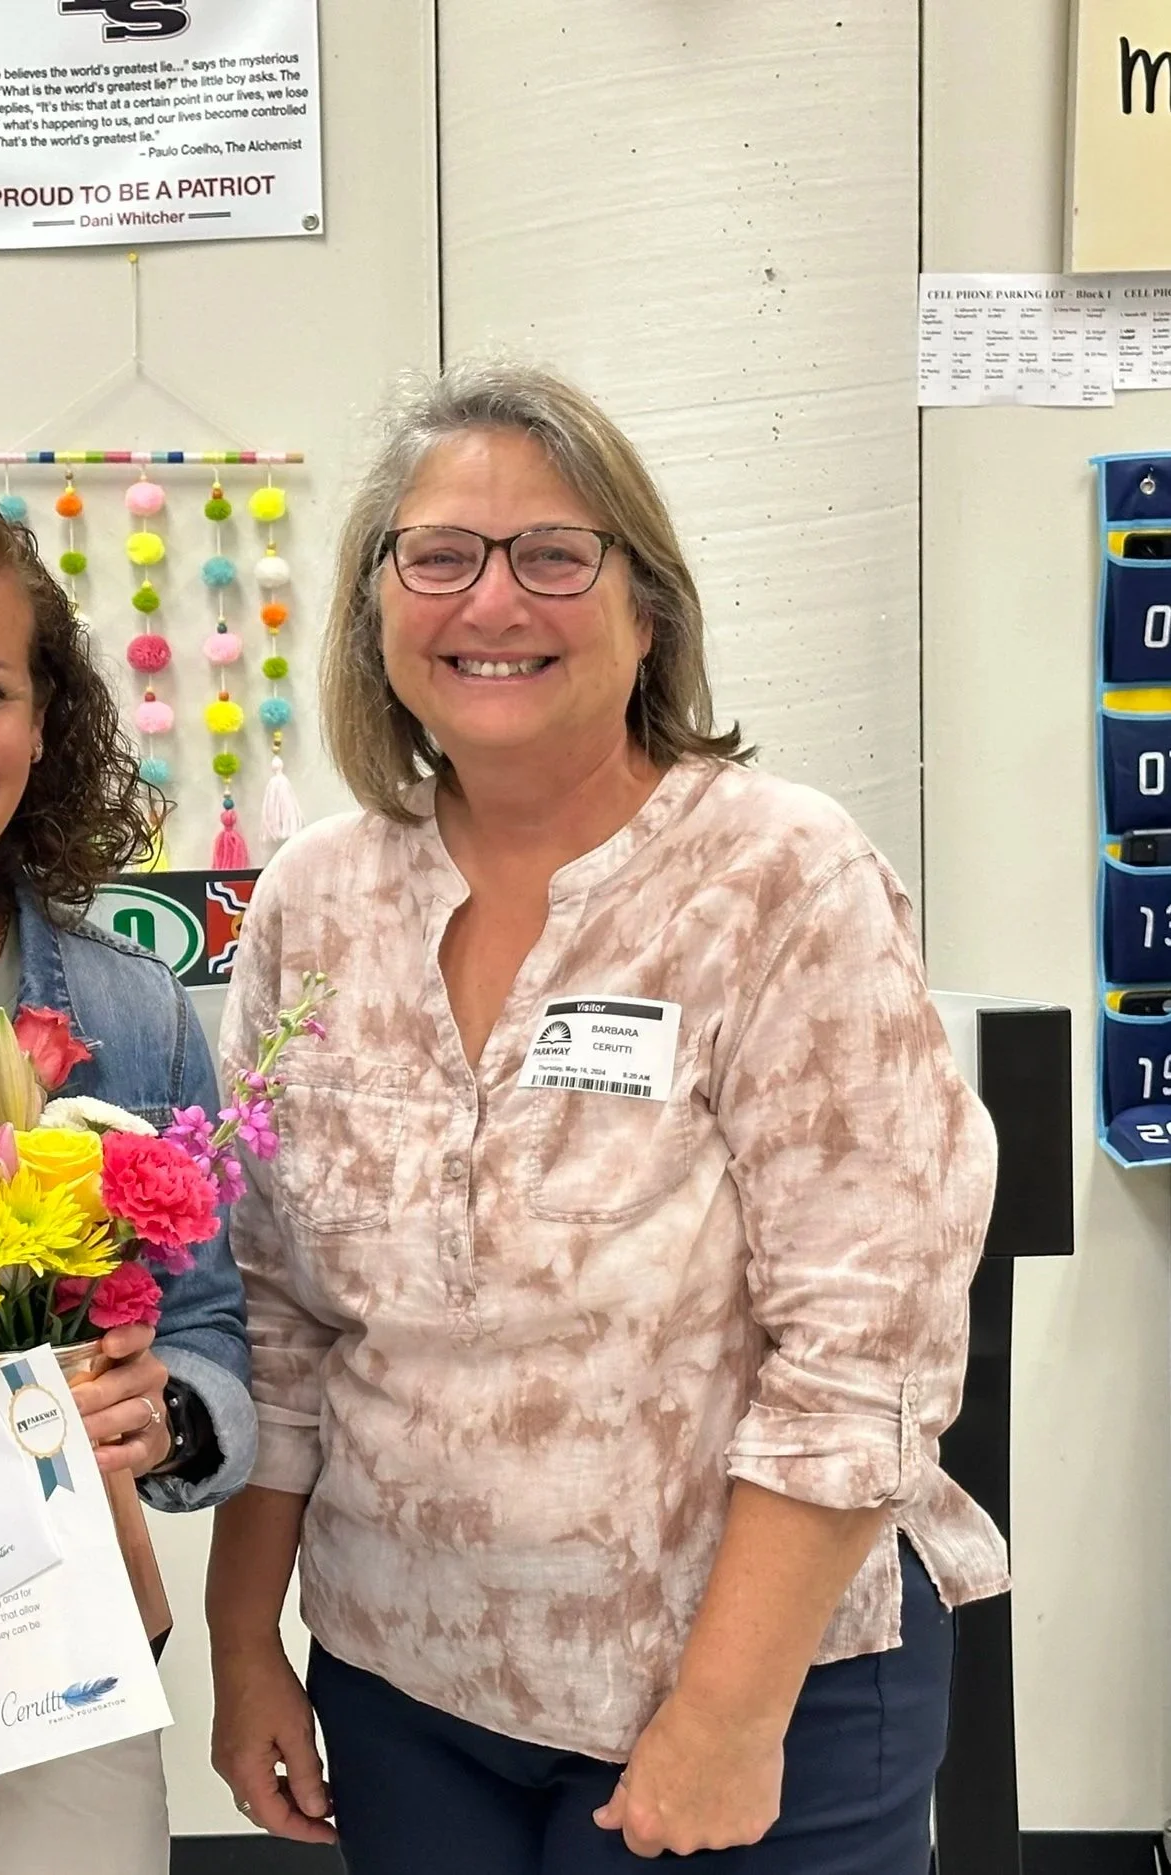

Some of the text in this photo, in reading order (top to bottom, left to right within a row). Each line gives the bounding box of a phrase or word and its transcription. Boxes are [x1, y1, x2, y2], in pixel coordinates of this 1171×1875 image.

[4, 68, 47, 80] believes
[51, 66, 67, 78] the
[71, 64, 109, 76] world's
[113, 60, 158, 76] greatest
[192, 58, 216, 72] says
[219, 57, 236, 68] the
[239, 53, 299, 67] mysterious
[33, 84, 42, 95] is
[45, 84, 61, 95] the
[65, 82, 104, 94] world's
[107, 79, 152, 95] greatest
[181, 77, 198, 88] the
[201, 74, 223, 86] little
[227, 73, 246, 86] boy
[249, 71, 277, 82] asks.
[280, 70, 300, 81] The
[86, 99, 107, 110] that
[110, 99, 120, 109] at
[124, 100, 130, 109] a
[133, 97, 171, 109] certain
[174, 94, 200, 107] point
[204, 93, 213, 103] in
[216, 92, 234, 103] our
[237, 89, 264, 101] lives,
[267, 89, 282, 99] we
[286, 87, 308, 98] lose
[3, 119, 38, 130] what's
[42, 118, 98, 131] happening
[102, 117, 112, 127] to
[134, 114, 154, 126] and
[158, 113, 175, 124] our
[178, 111, 201, 122] lives
[205, 108, 249, 120] become
[251, 104, 307, 117] controlled
[31, 135, 47, 146] the
[50, 134, 89, 146] world's
[93, 132, 136, 147] greatest
[149, 138, 302, 158] Paulo Coelho, The Alchemist
[80, 185, 111, 204] TO
[119, 182, 149, 202] BE
[155, 181, 172, 200] A
[178, 175, 275, 198] PATRIOT
[80, 212, 185, 227] Dani Whitcher
[928, 289, 1104, 300] CELL PHONE PARKING LOT Block
[1124, 288, 1147, 297] CELL
[1139, 751, 1171, 796] 0
[576, 1003, 606, 1012] Visitor
[591, 1025, 639, 1037] BARBARA
[532, 1047, 570, 1056] PARKWAY
[592, 1042, 632, 1054] CERUTTI
[565, 1065, 578, 1074] May
[591, 1068, 606, 1076] 2024
[27, 1409, 57, 1424] PARKWAY
[3, 1588, 32, 1604] and for
[1, 1610, 18, 1623] that
[19, 1603, 40, 1616] allow
[12, 1626, 28, 1637] can
[1, 1691, 64, 1727] Cerutti
[48, 1698, 126, 1725] FAMILY FOUNDATION
